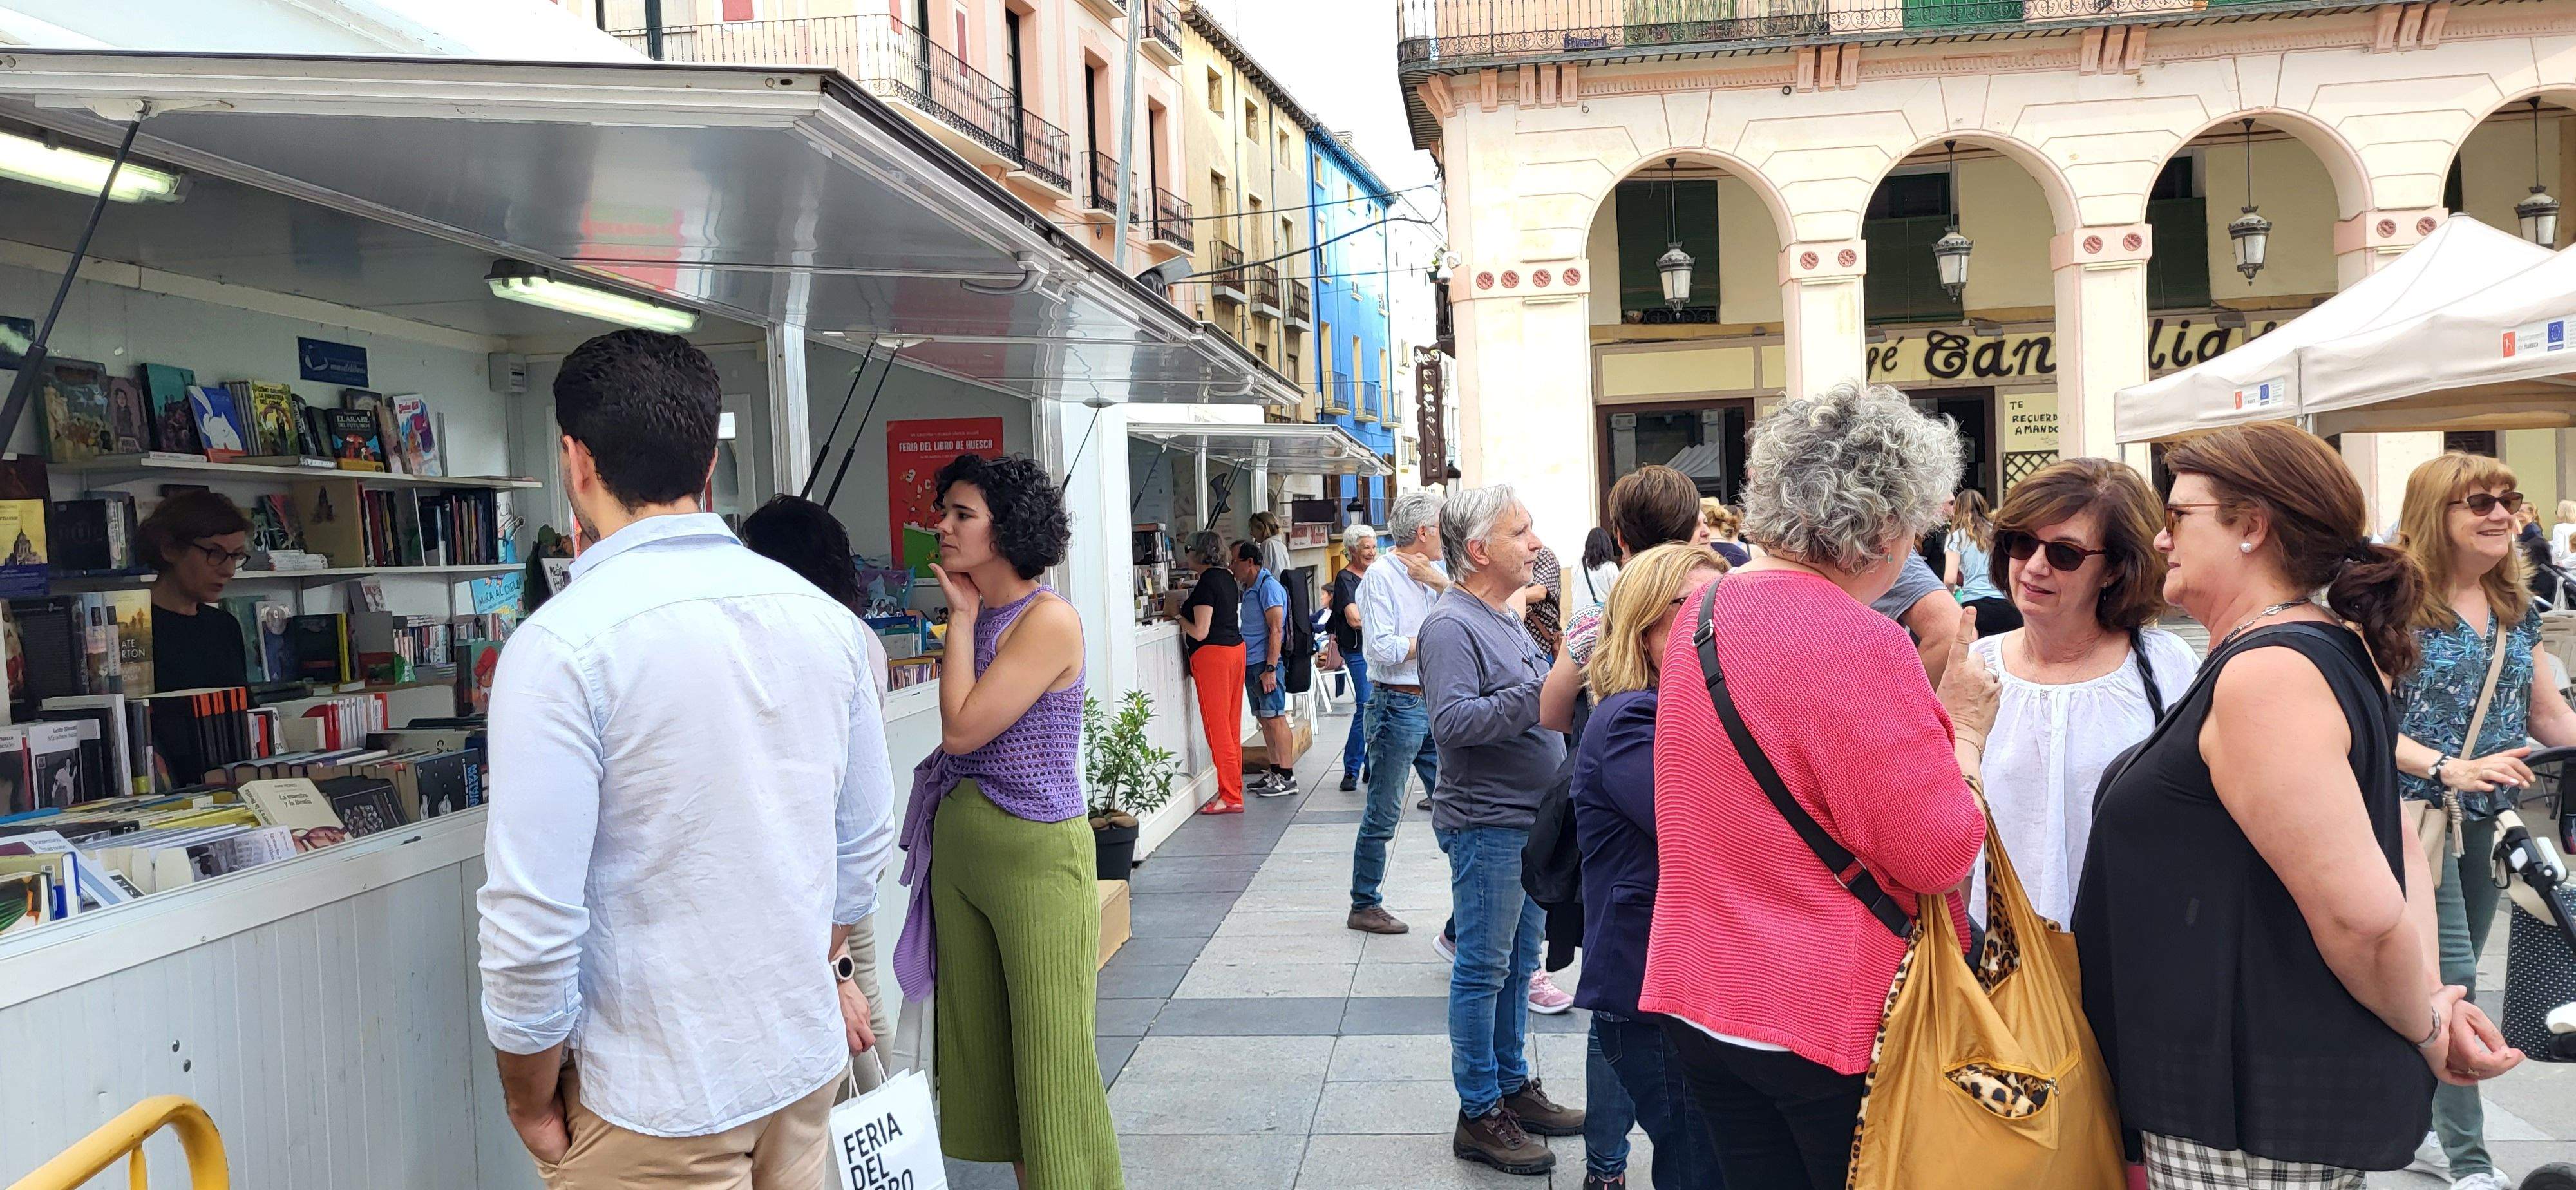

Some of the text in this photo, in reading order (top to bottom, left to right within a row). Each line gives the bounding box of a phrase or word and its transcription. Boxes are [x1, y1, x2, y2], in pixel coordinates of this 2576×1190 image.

[1867, 336, 1905, 380] fé
[2148, 319, 2231, 370] lia
[2010, 401, 2023, 410] TE
[2012, 413, 2058, 423] RECUERD
[899, 439, 992, 452] FERIA DEL LIBRO DE HUESCA
[121, 639, 135, 648] ATE
[122, 648, 146, 659] RTON
[843, 1112, 903, 1164] FERIA
[850, 1153, 890, 1190] DEL
